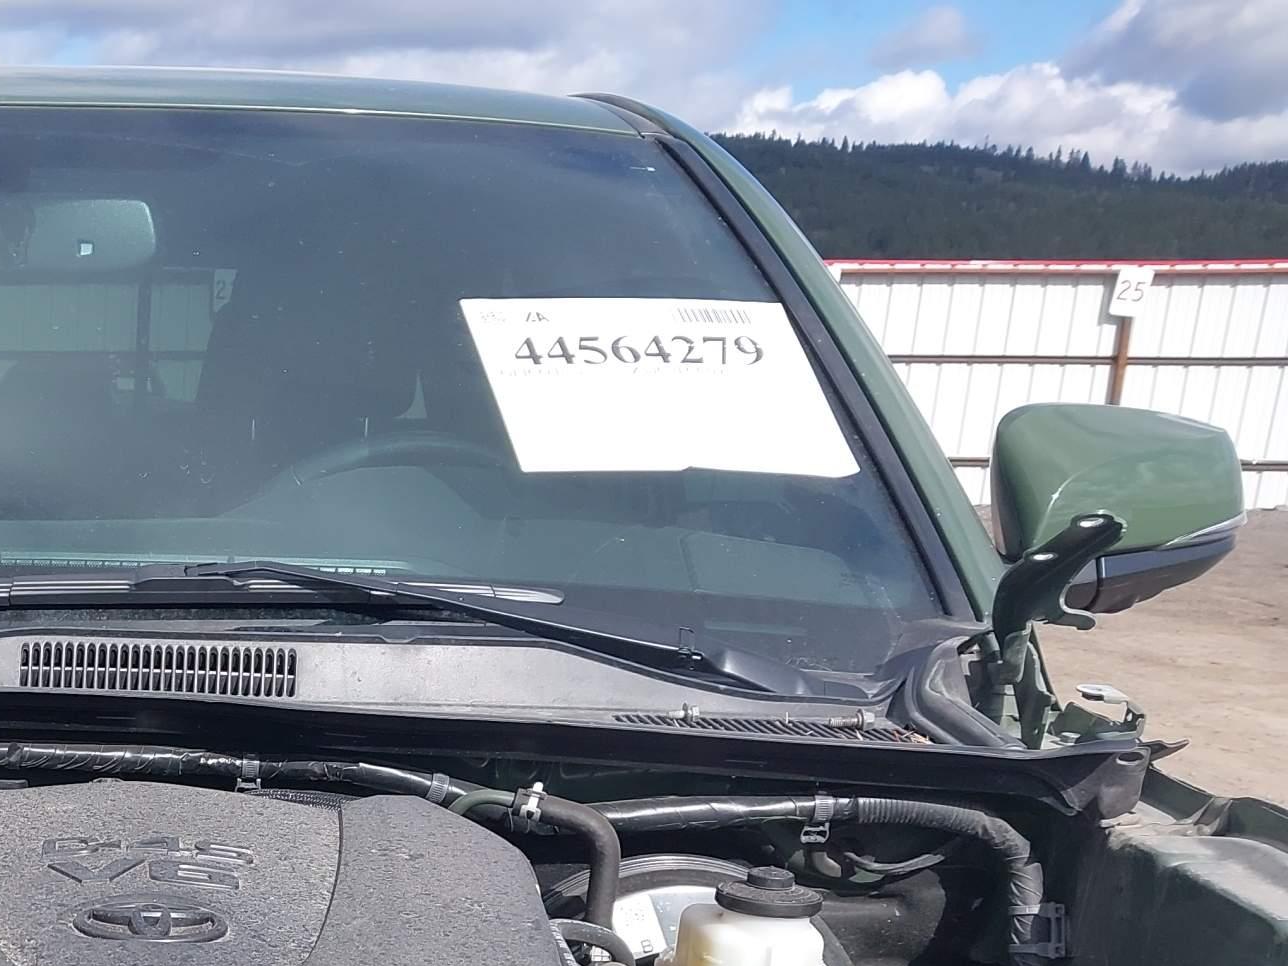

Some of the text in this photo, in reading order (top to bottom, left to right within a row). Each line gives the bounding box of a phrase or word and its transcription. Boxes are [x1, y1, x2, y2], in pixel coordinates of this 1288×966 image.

[1116, 279, 1146, 302] 25
[514, 335, 765, 366] 44564279
[46, 857, 240, 890] V6
